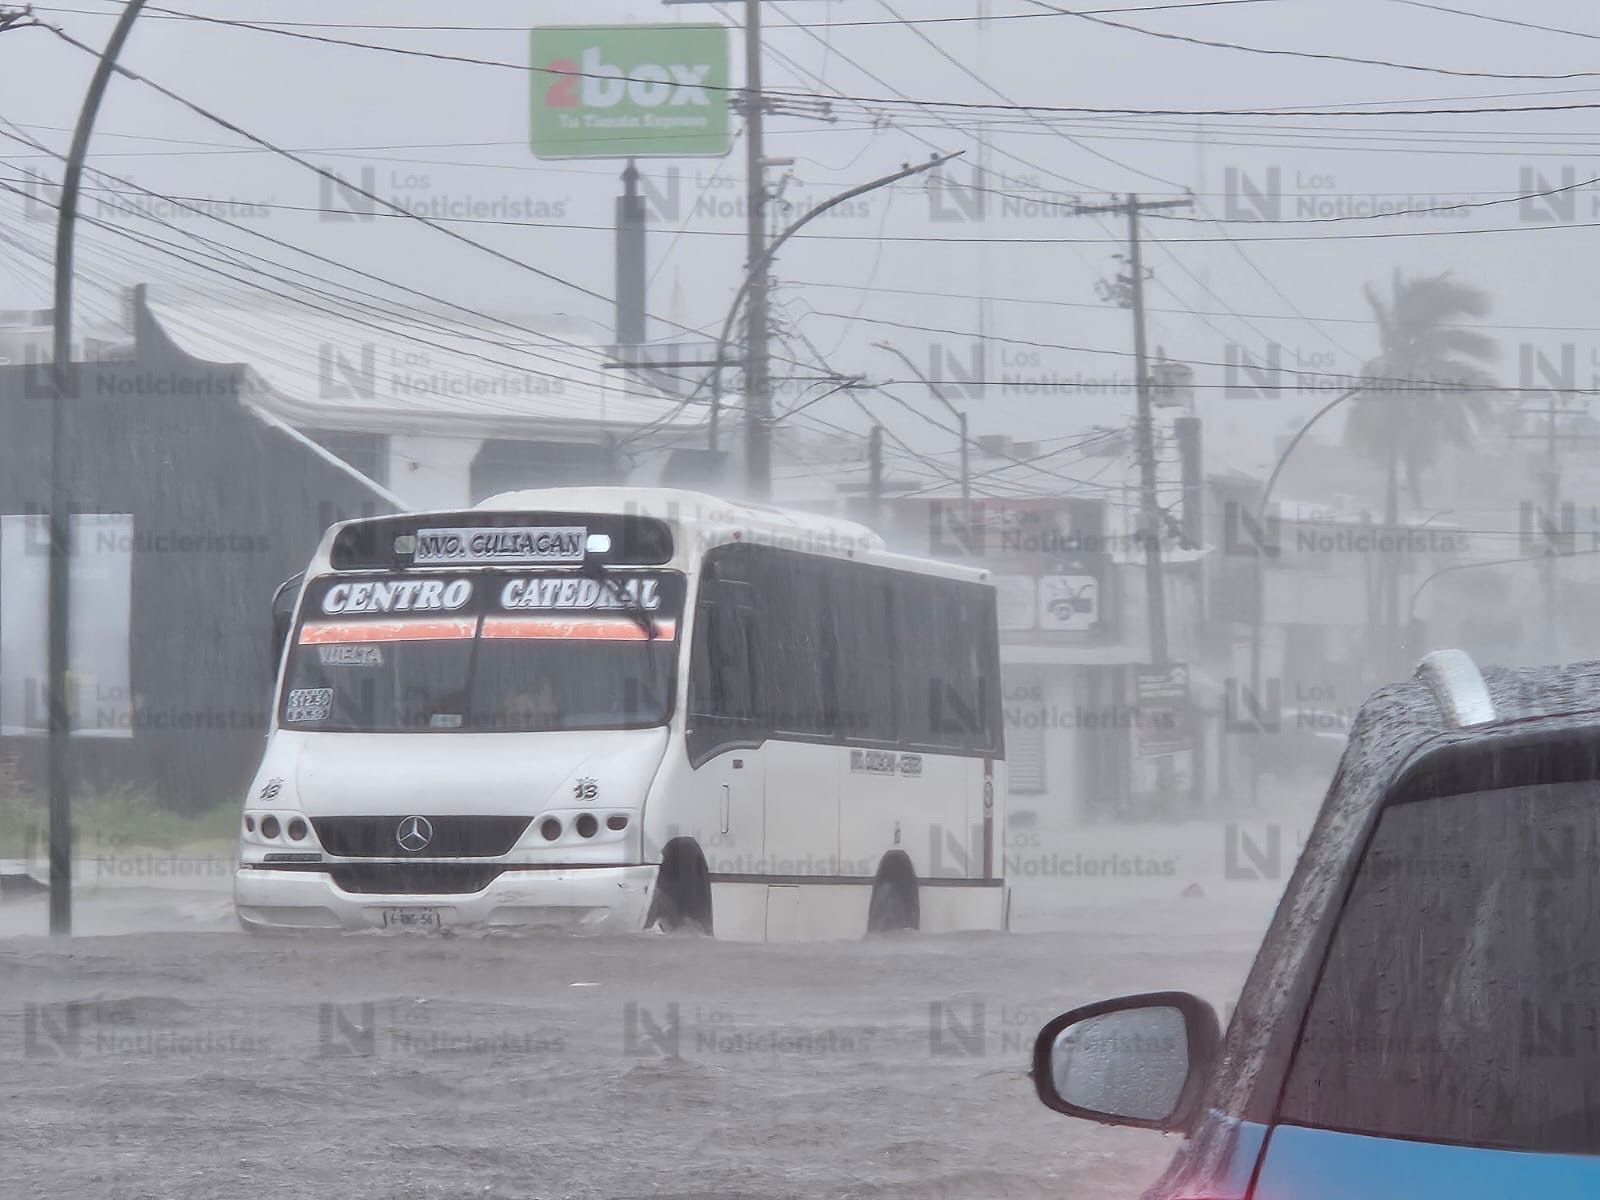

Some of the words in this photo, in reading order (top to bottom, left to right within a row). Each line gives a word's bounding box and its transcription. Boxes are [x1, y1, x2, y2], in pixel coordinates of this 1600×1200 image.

[544, 45, 711, 109] 2box
[419, 533, 466, 556] NVO.
[322, 579, 474, 614] CENTRO
[501, 578, 660, 610] CATEDRAL
[260, 784, 282, 800] 13
[574, 784, 598, 800] 13
